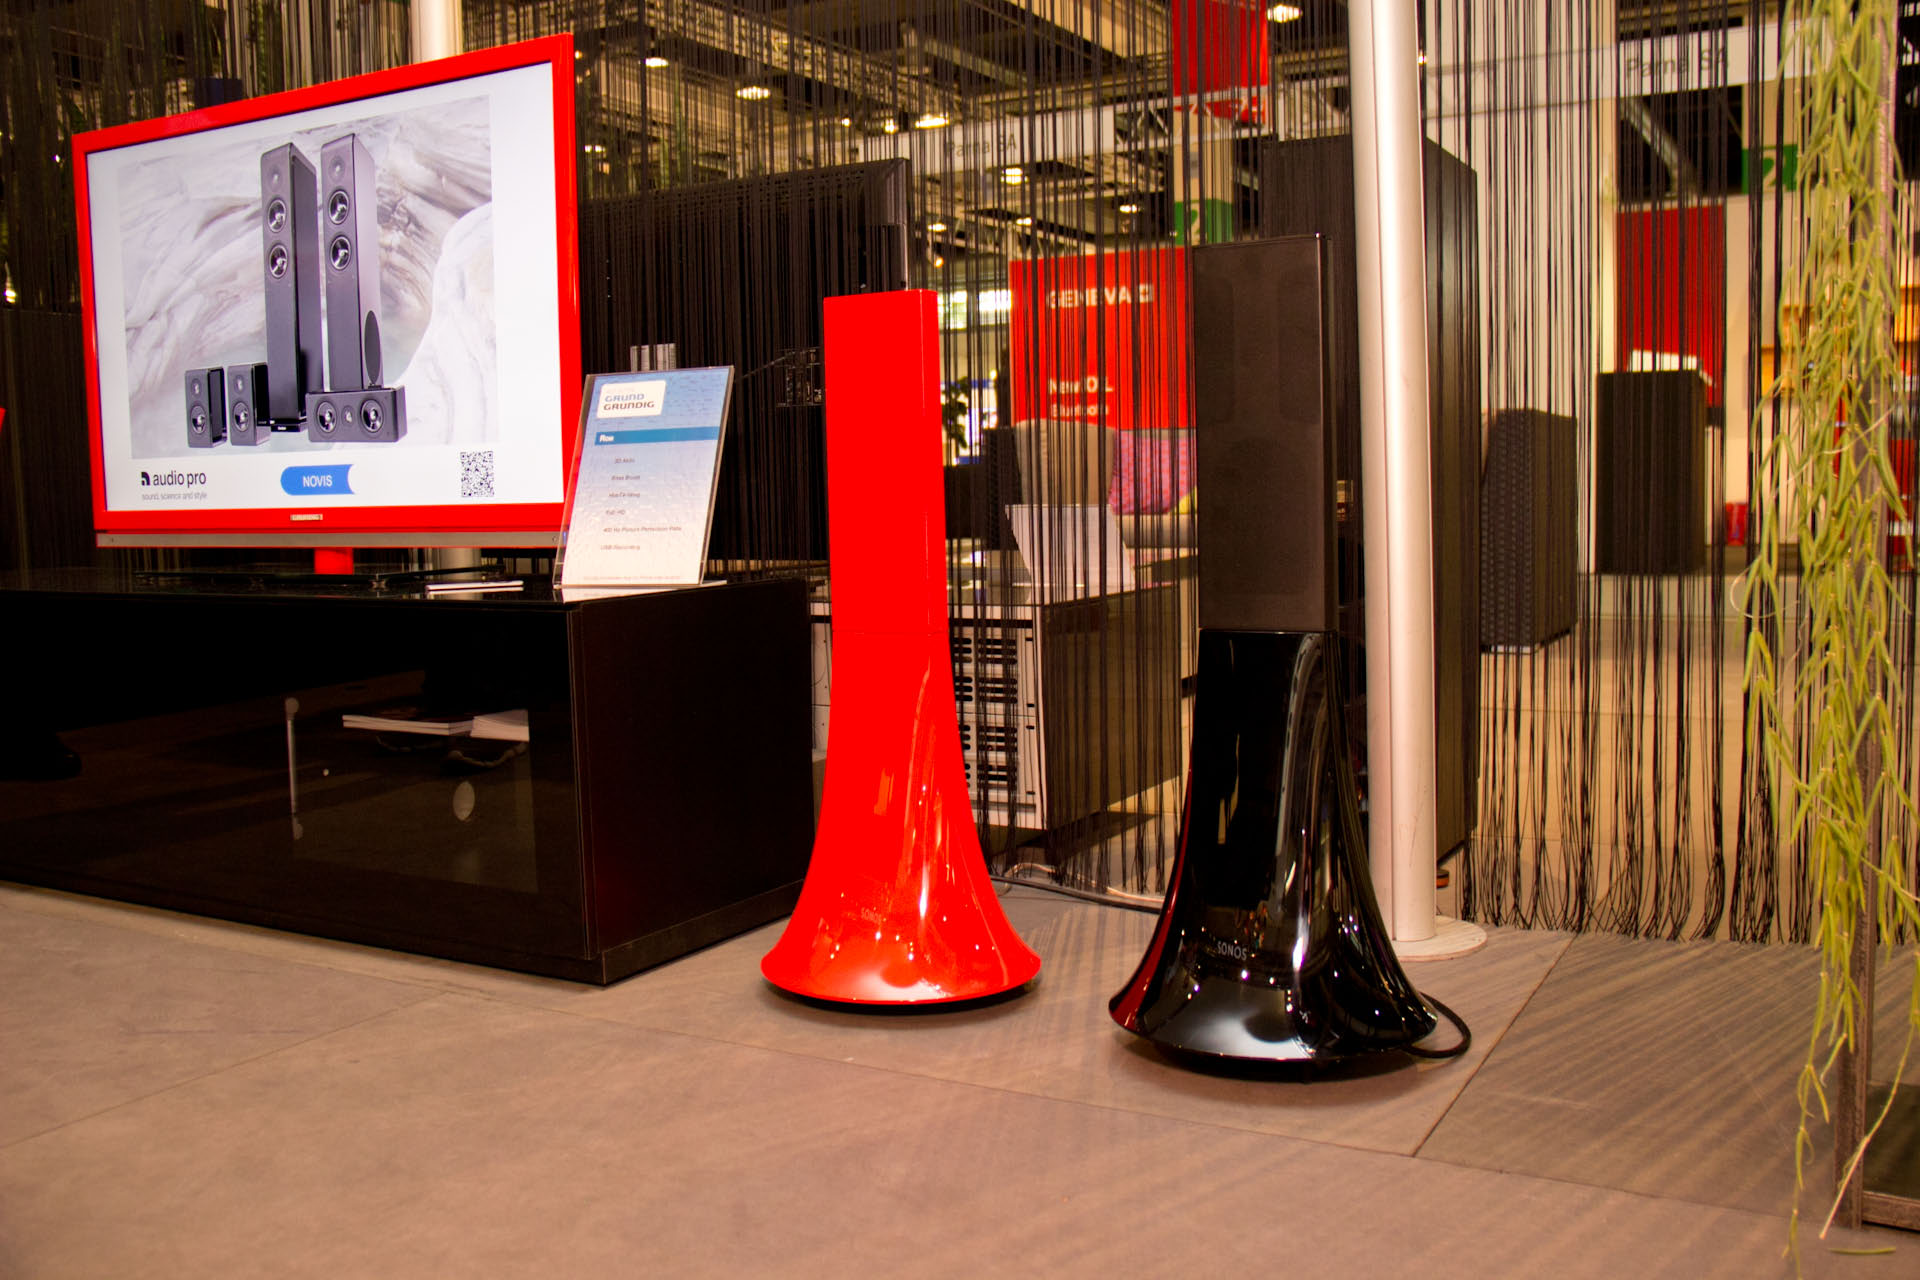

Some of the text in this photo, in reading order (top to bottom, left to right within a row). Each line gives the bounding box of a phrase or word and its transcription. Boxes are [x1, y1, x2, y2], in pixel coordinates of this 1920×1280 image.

[603, 400, 656, 411] GRUNDIG
[153, 470, 207, 488] audio pro
[303, 475, 333, 488] NOVIS
[1217, 940, 1247, 961] SONOS
